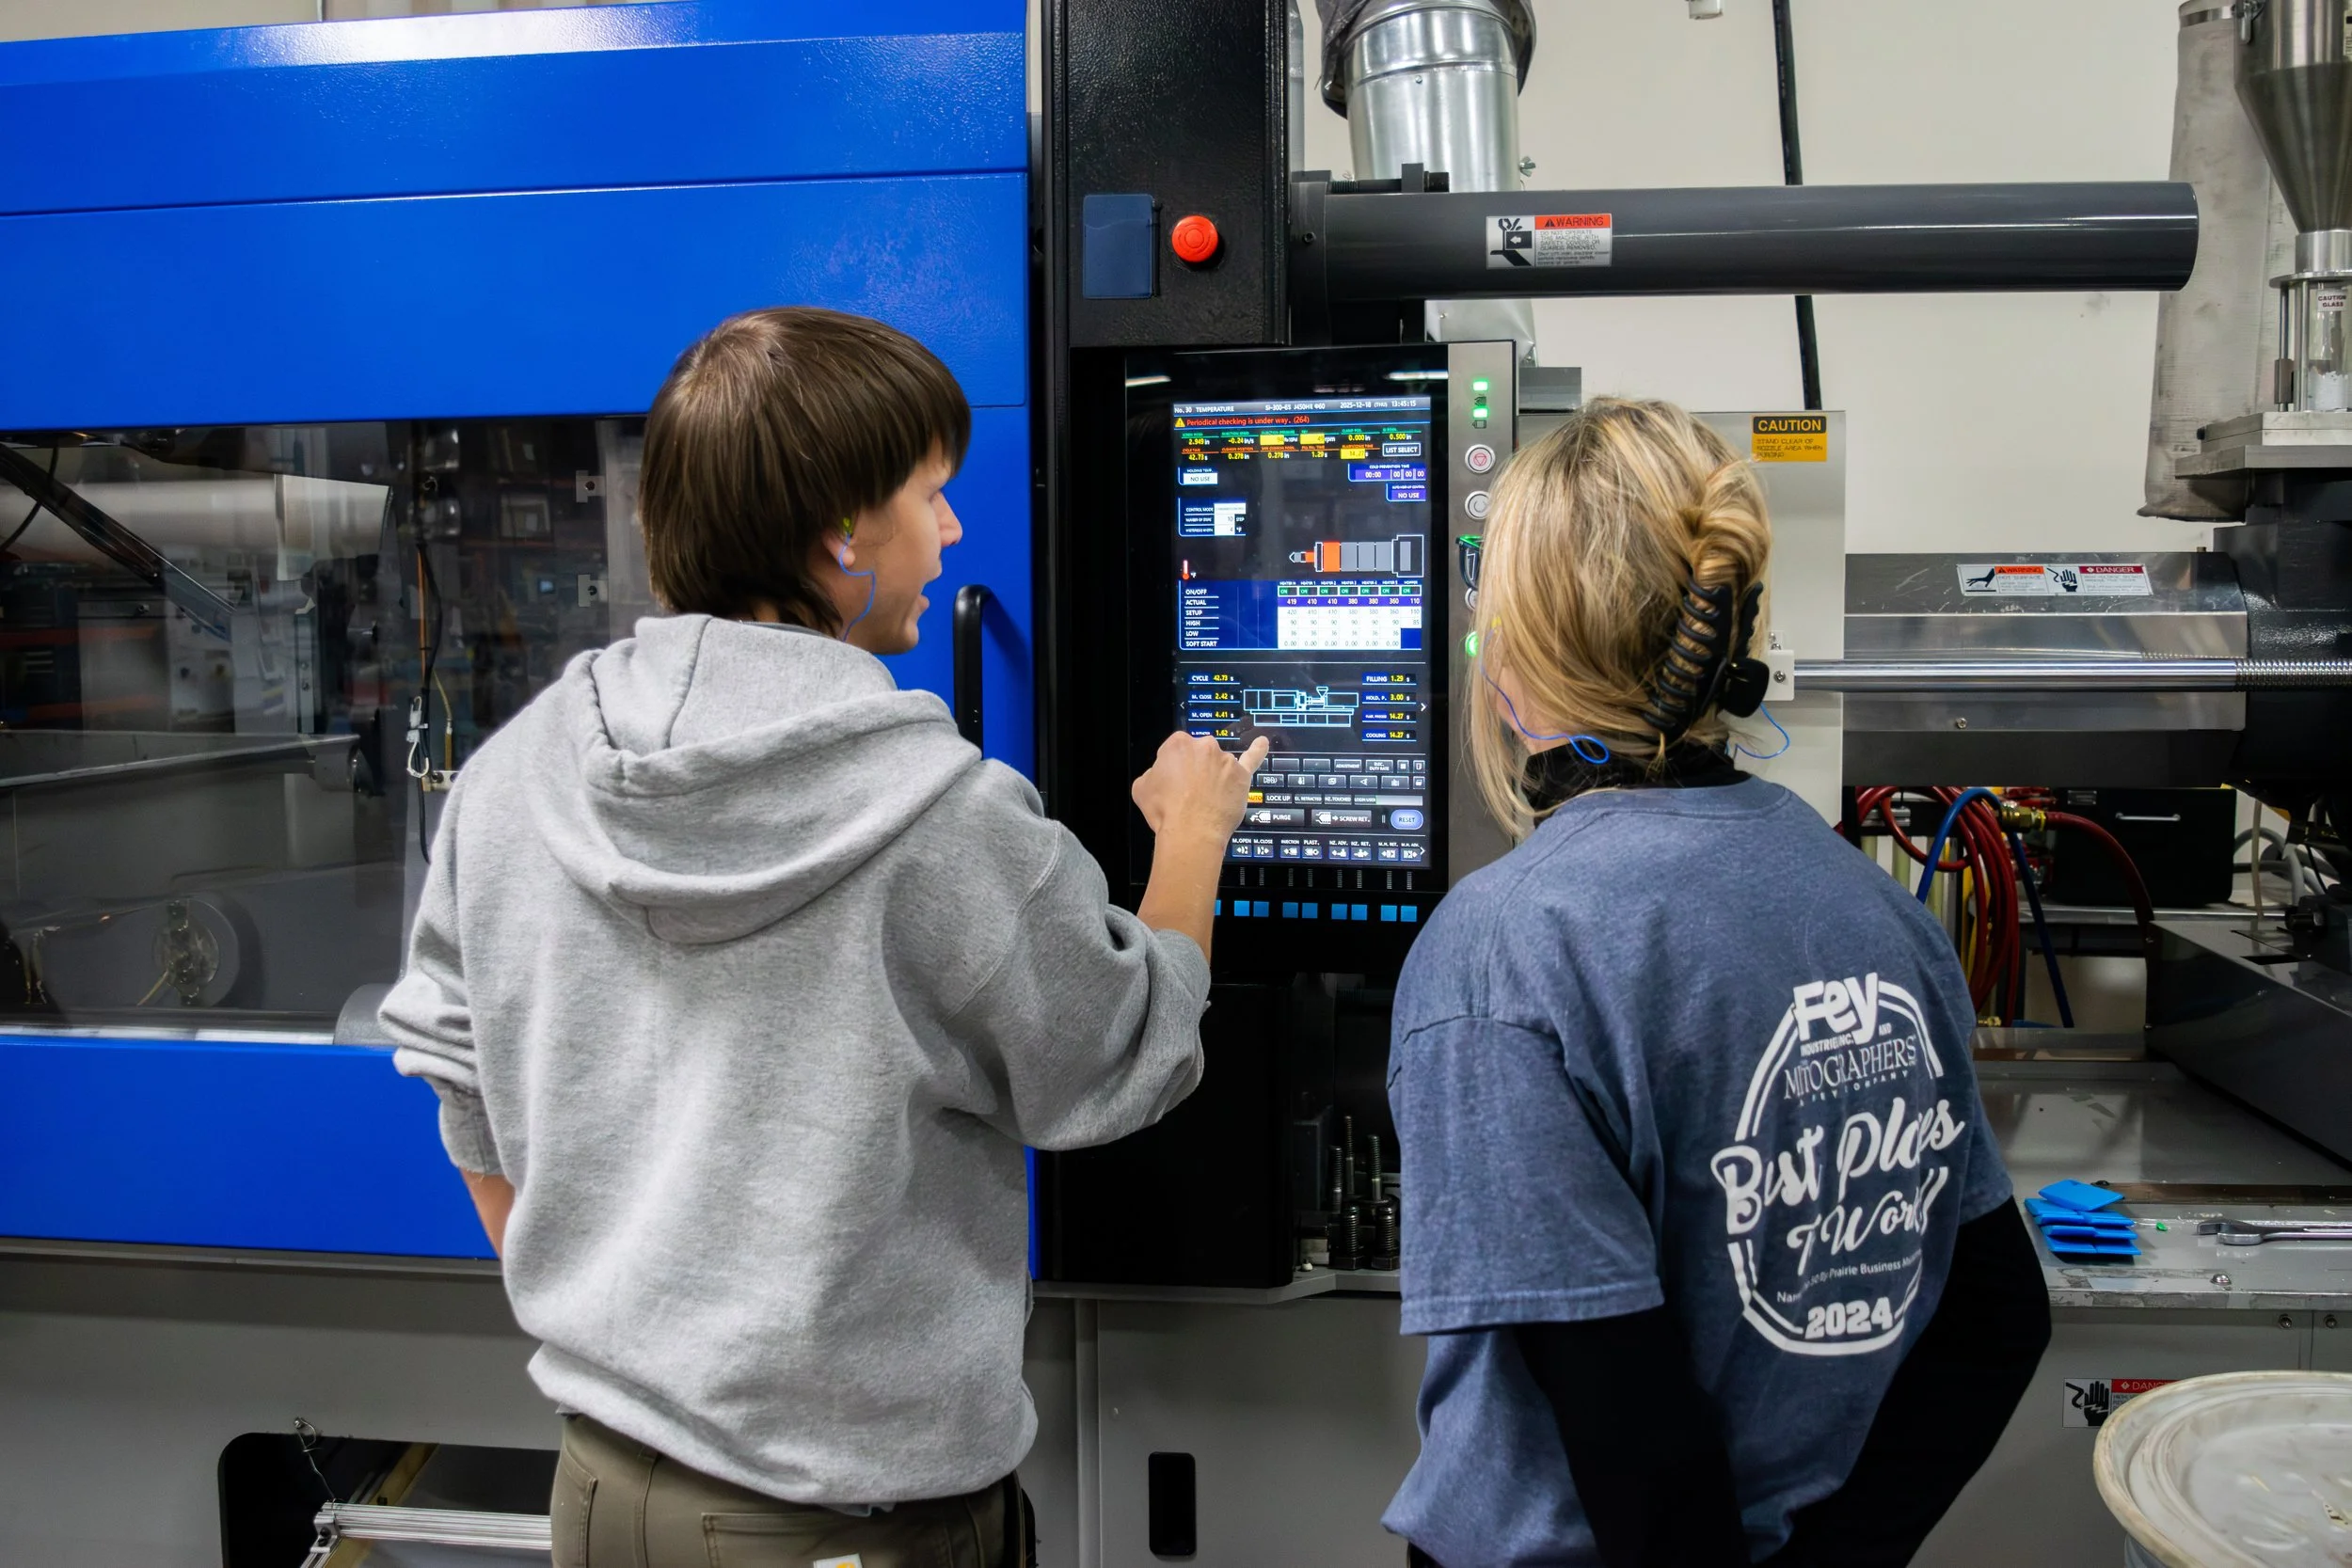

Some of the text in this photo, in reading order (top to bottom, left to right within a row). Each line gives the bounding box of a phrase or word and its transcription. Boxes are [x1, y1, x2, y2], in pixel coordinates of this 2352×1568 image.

[1556, 217, 1604, 227] WARNING
[1218, 418, 1247, 426] checking
[1275, 417, 1292, 425] way.
[1757, 419, 1822, 432] CAUTION
[1793, 972, 1878, 1045] Fey
[1879, 1022, 1893, 1036] AND
[1836, 1097, 1965, 1201] Plaes
[1829, 1265, 1858, 1279] Prairie
[1860, 1260, 1901, 1275] Business
[1804, 1297, 1895, 1340] 2024
